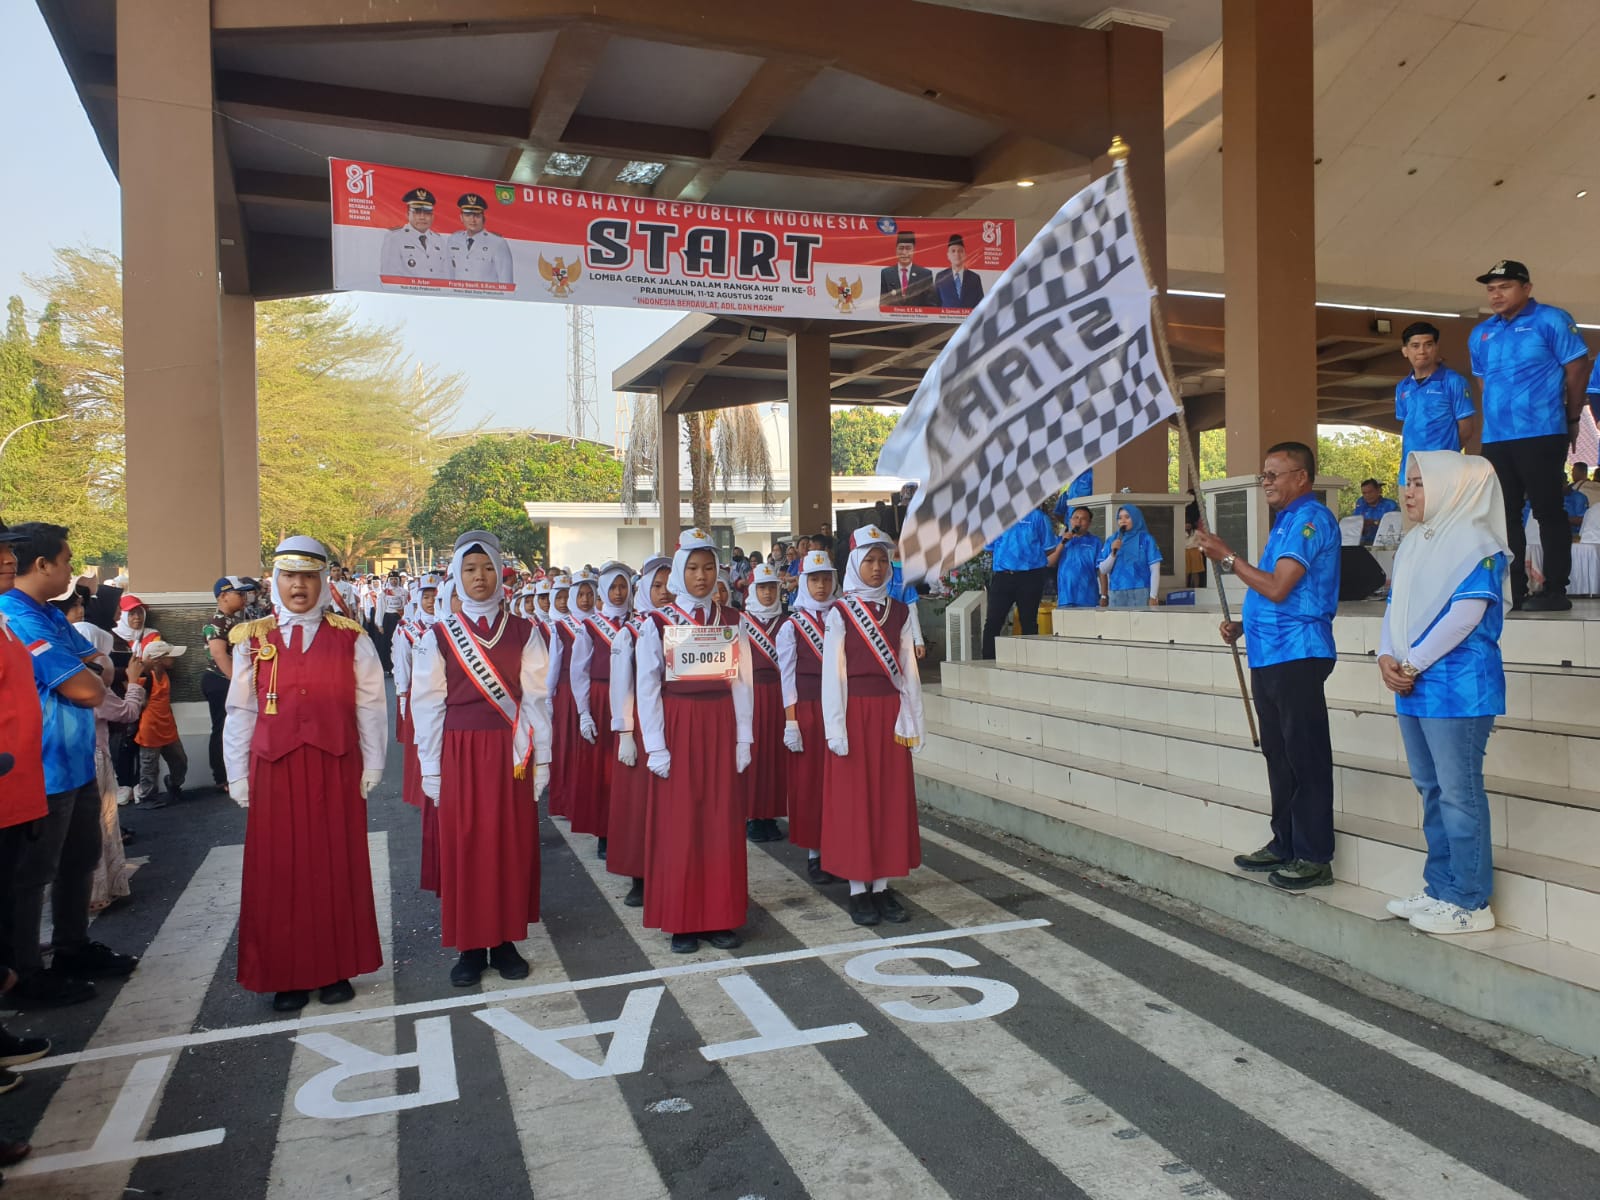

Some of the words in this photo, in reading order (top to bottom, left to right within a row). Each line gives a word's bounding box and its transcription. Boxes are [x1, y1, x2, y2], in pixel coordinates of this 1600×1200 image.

[346, 164, 375, 198] 81
[523, 187, 646, 214] DIRGAHAYU
[656, 203, 756, 224] REPUBLIK
[765, 210, 869, 231] INDONESIA
[585, 217, 823, 284] START
[982, 221, 1004, 247] 81
[589, 272, 623, 282] LOMBA
[625, 275, 656, 284] GERAK
[659, 278, 688, 287] JALAN
[690, 280, 721, 289] DALAM
[723, 283, 760, 291] RANGKA
[762, 285, 779, 293] HUT
[640, 286, 696, 297] PRABUMULIH,
[697, 290, 714, 298] 11-12
[716, 291, 753, 300] AGUSTUS
[2, 946, 1020, 1178] START
